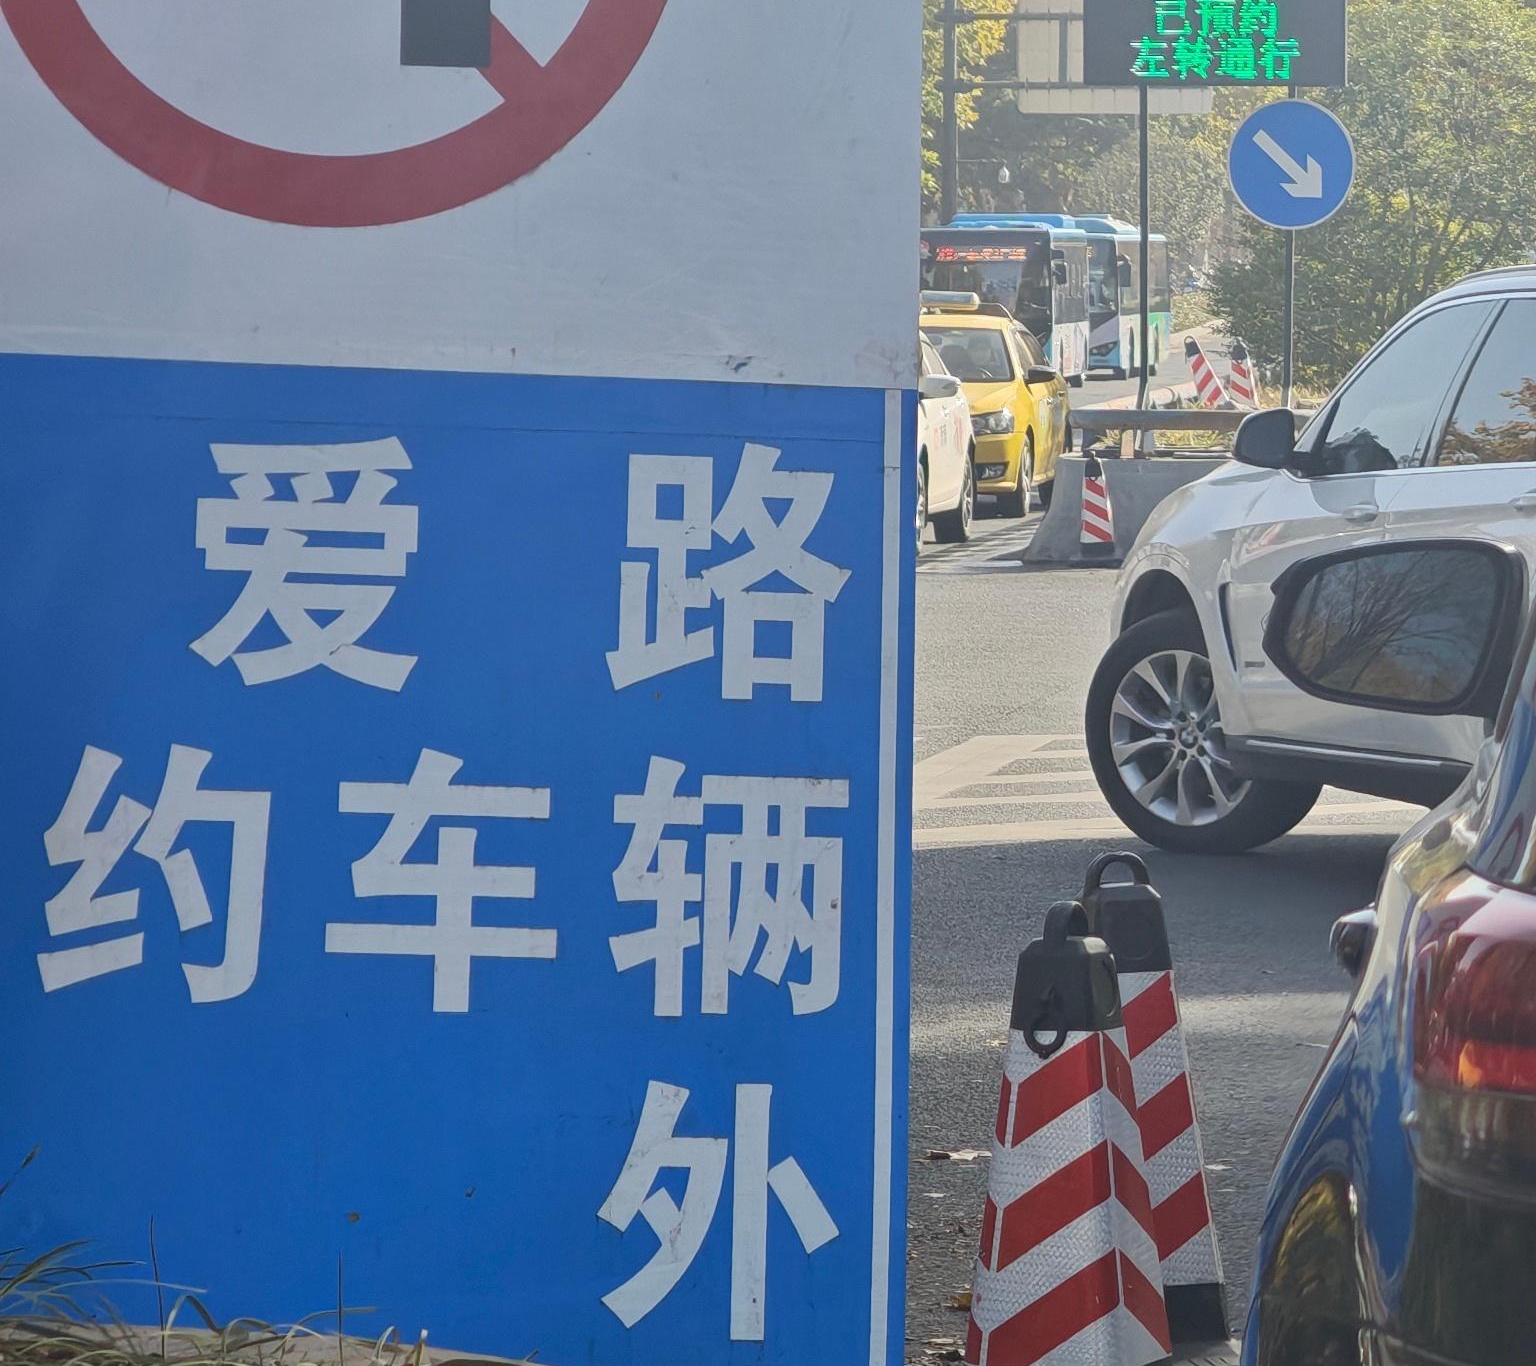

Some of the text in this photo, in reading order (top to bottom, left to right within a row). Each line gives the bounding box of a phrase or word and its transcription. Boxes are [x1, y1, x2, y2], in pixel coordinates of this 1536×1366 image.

[1129, 37, 1301, 80] 左转通行
[597, 1079, 840, 1342] 外
